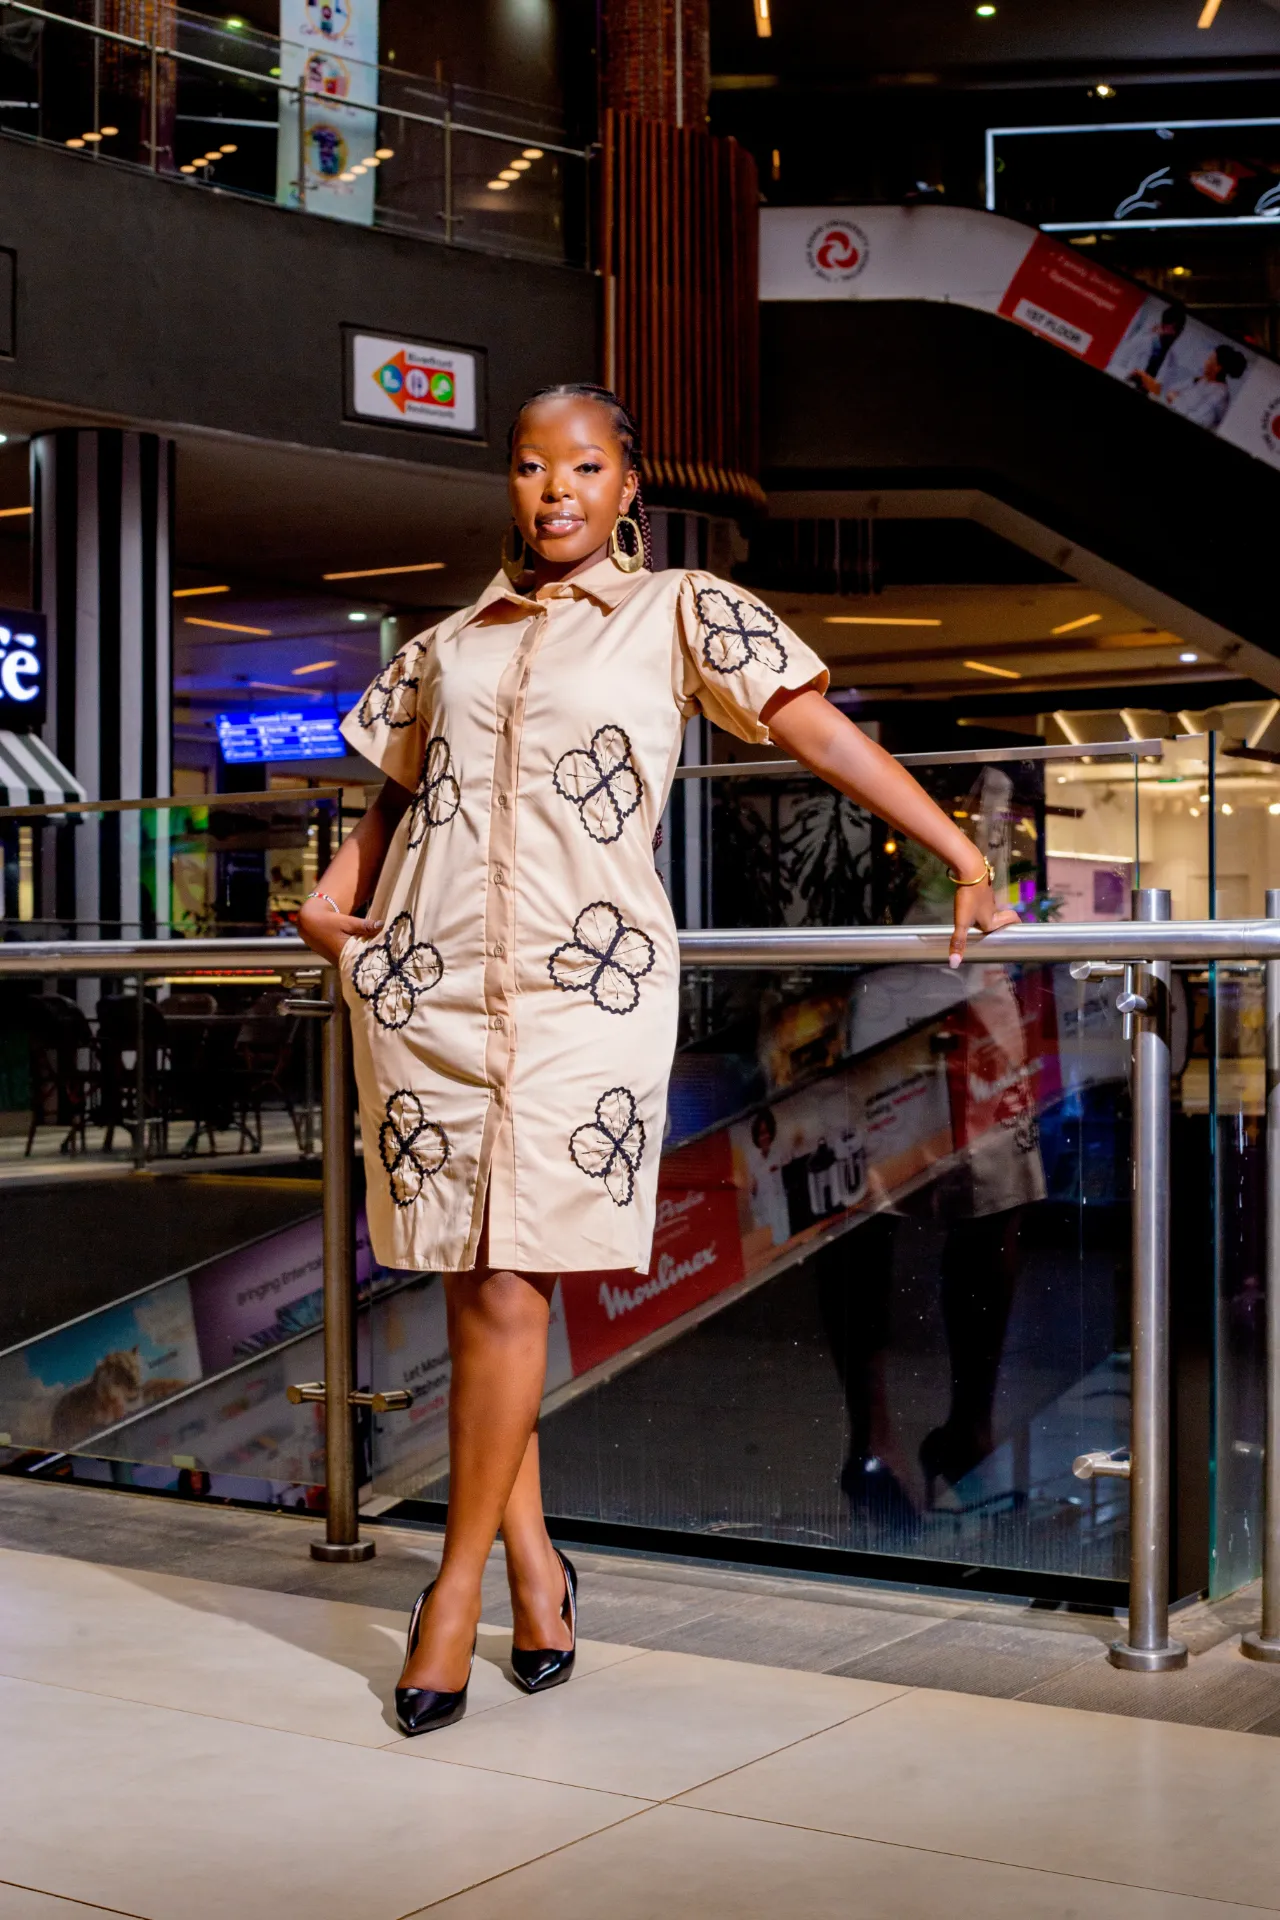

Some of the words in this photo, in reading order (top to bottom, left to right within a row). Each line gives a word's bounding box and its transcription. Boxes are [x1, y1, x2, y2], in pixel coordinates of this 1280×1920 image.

[1025, 307, 1045, 322] 1ST
[1044, 317, 1082, 345] FLOOR
[598, 1240, 718, 1321] Moulinex
